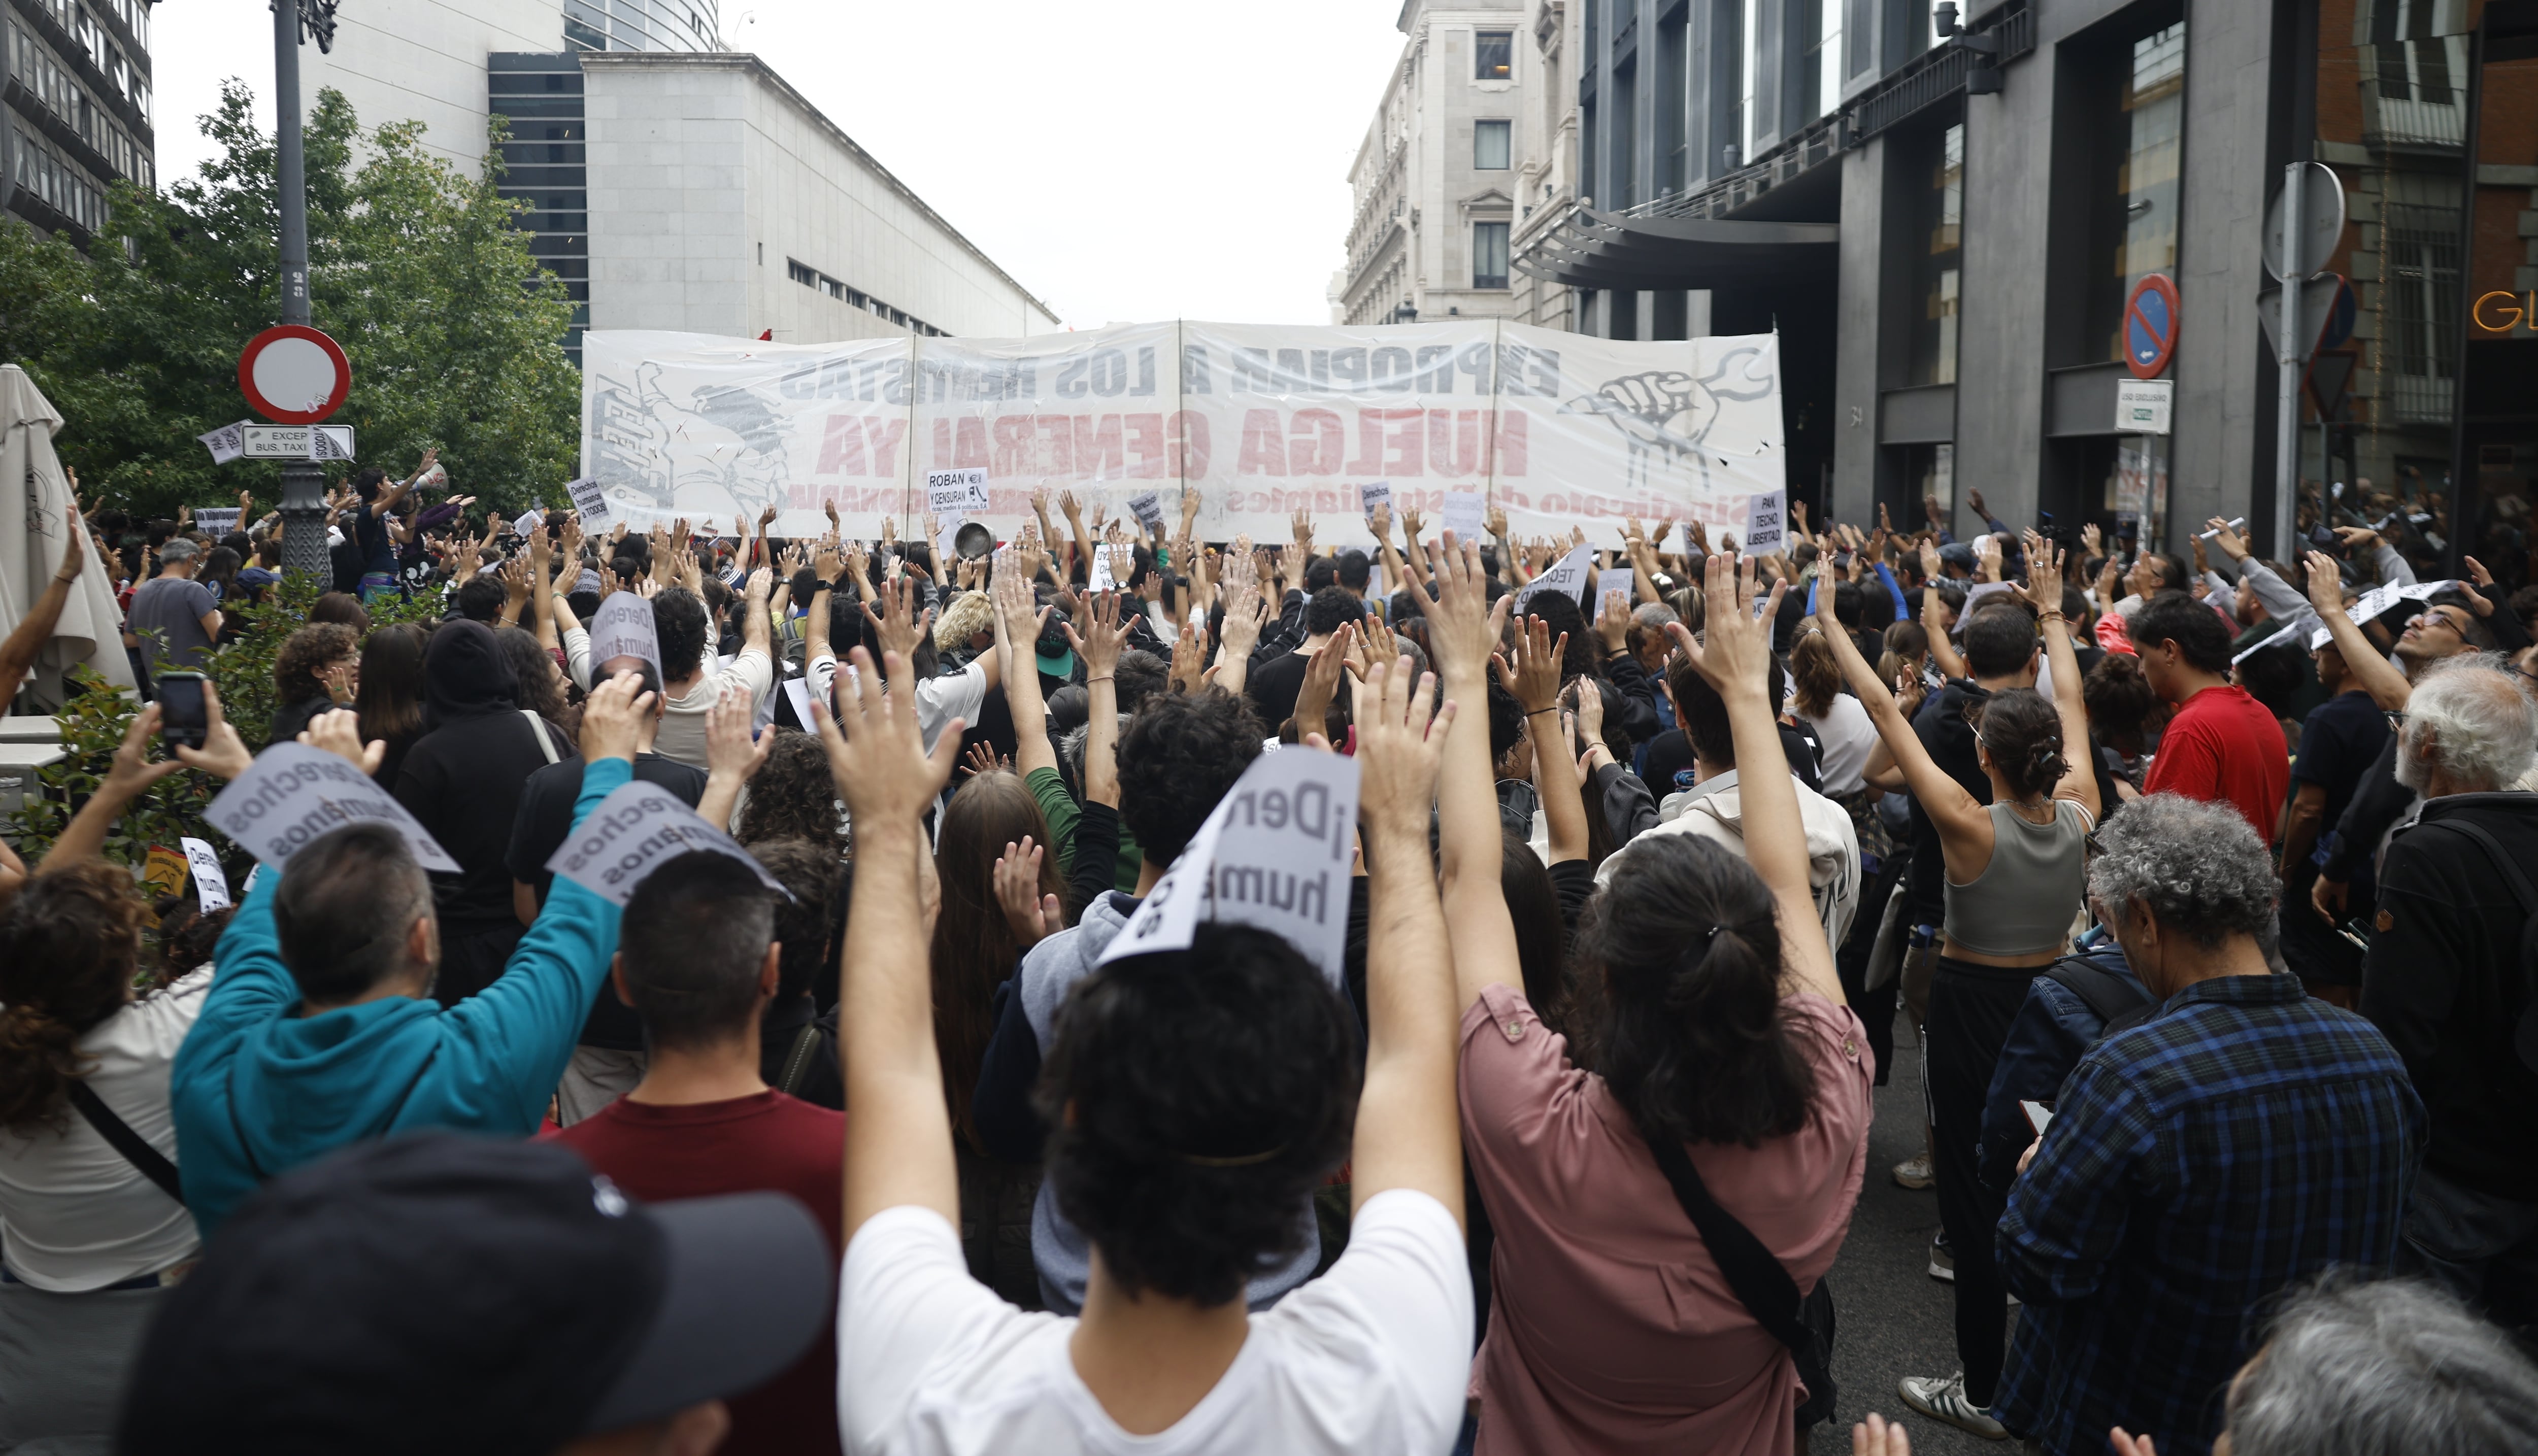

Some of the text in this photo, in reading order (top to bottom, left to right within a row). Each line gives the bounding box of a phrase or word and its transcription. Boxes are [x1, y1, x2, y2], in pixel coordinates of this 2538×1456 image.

[273, 432, 308, 440] EXCEP
[256, 444, 280, 452] BUS,
[929, 473, 964, 487] ROBAN
[570, 481, 597, 498] ¡Derechos
[576, 493, 602, 507] humanos
[930, 491, 965, 505] Y CENSURAN
[1762, 496, 1776, 510] PAN,
[1756, 512, 1778, 528] TECHO,
[1747, 529, 1782, 546] LIBERTAD.
